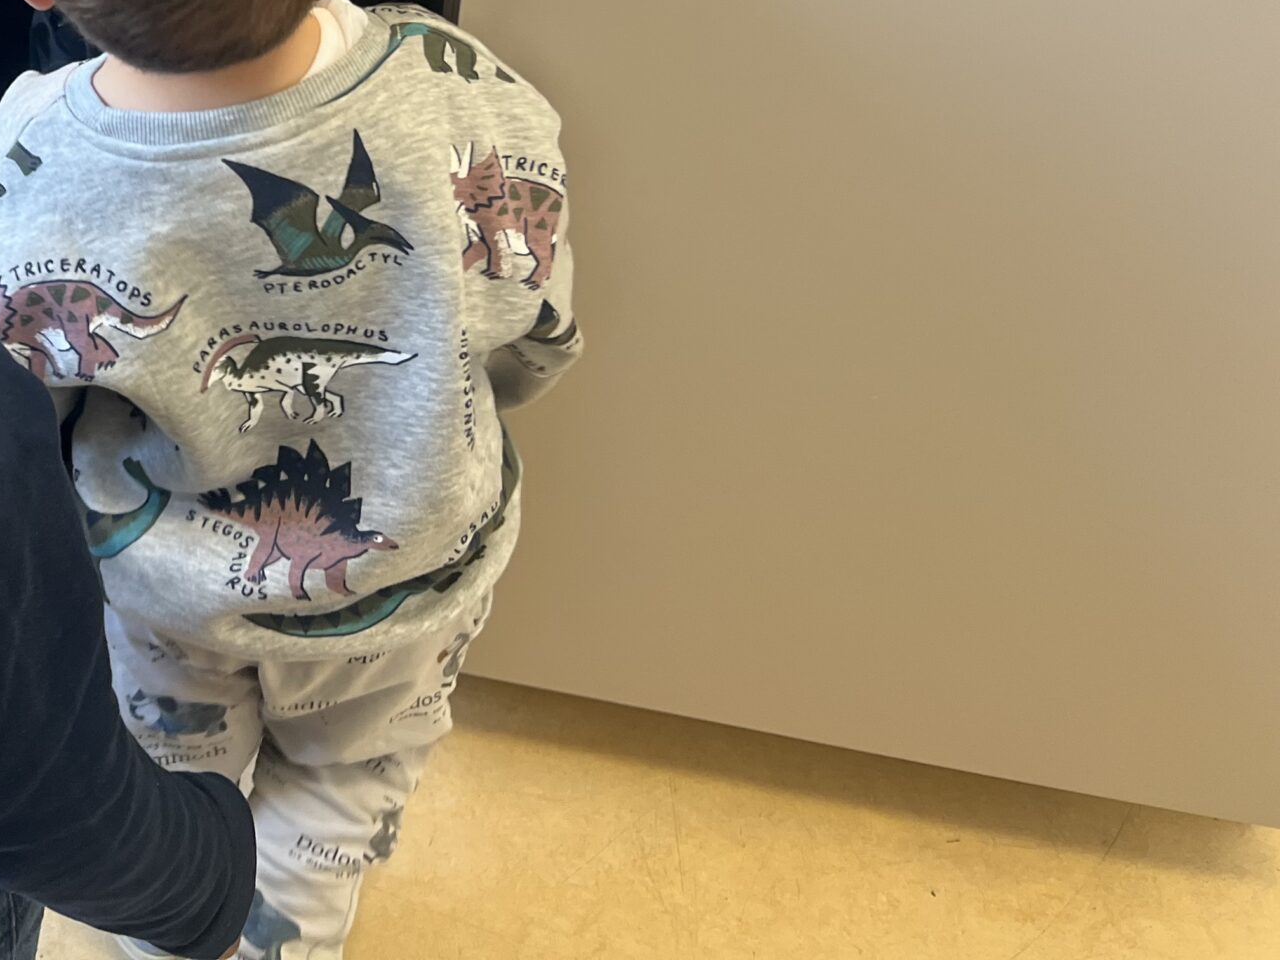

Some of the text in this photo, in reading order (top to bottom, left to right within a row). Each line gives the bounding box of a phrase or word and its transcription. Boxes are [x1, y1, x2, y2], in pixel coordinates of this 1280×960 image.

[9, 258, 153, 307] TRICERATOPS
[263, 252, 404, 294] PTERODACTYL
[192, 321, 389, 373] PARASAUROLOPHUS
[186, 509, 268, 600] STEGOSAURUS
